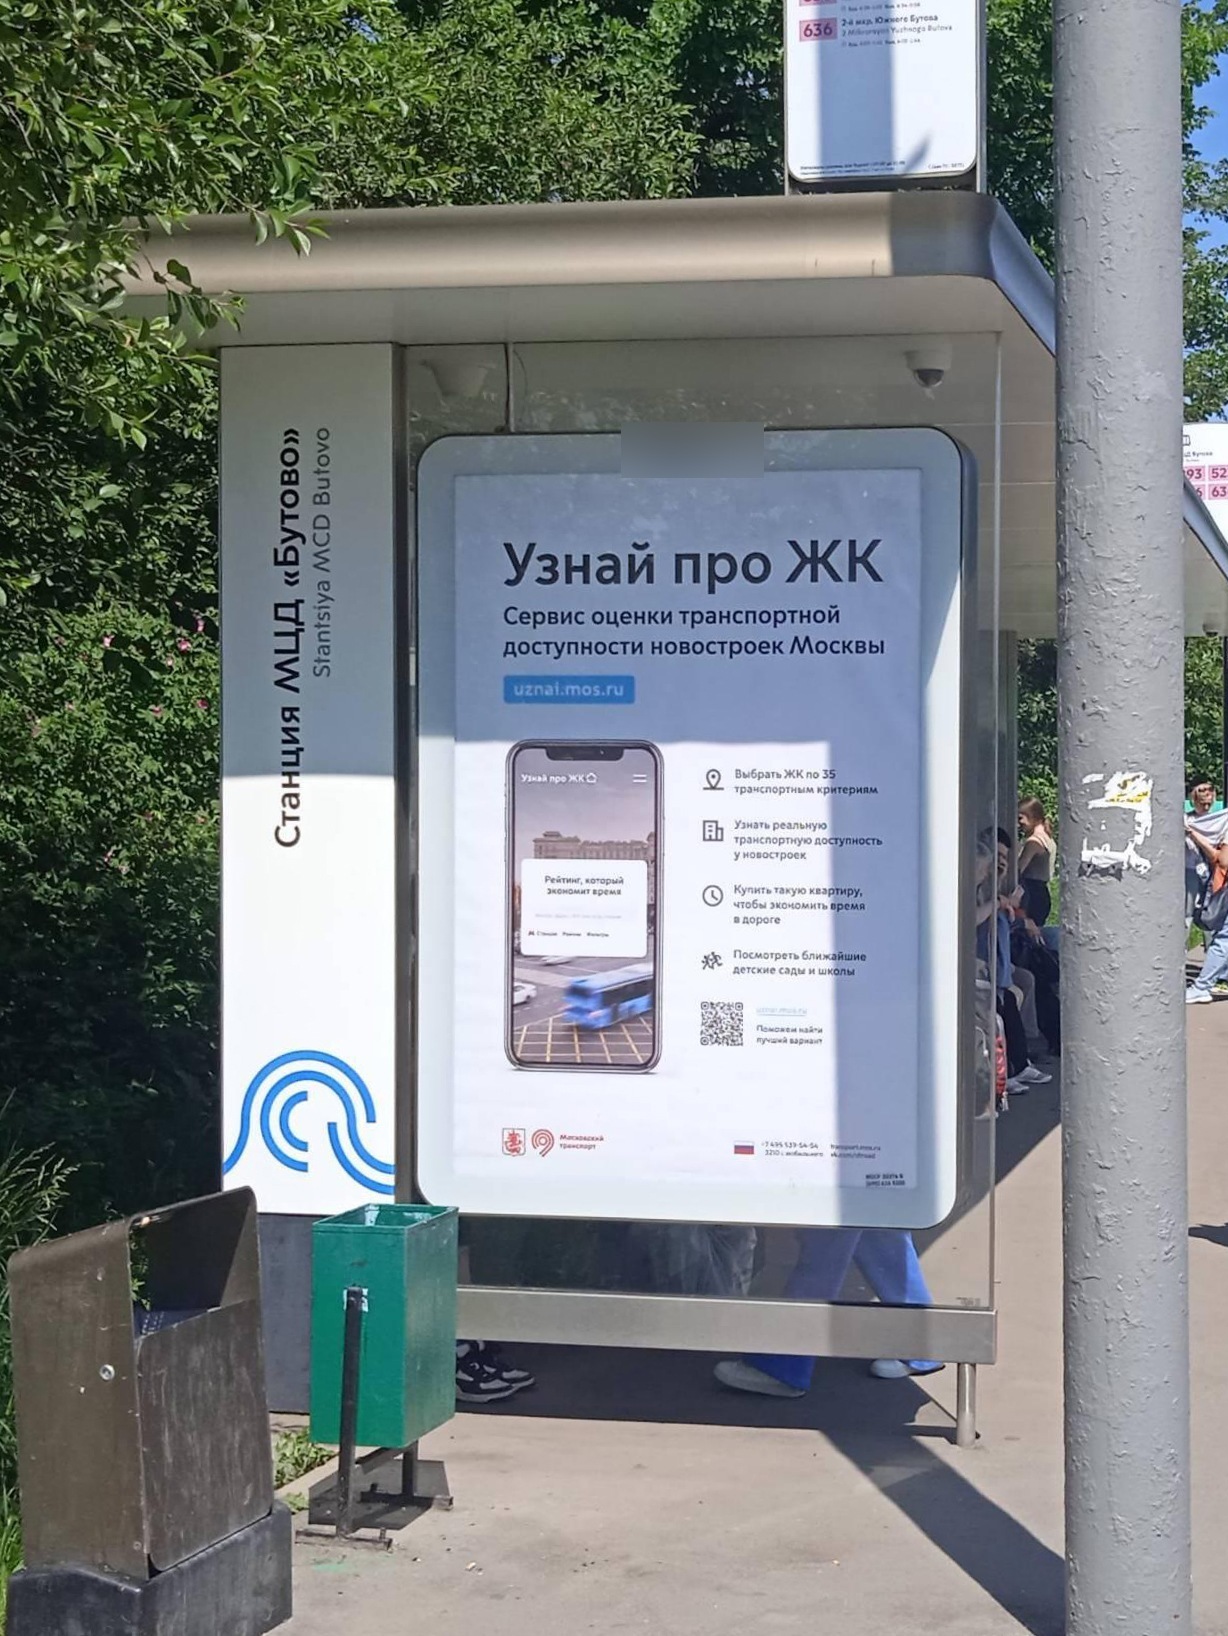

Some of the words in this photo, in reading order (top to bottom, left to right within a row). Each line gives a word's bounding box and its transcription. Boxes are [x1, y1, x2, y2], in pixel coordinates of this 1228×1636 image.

[875, 16, 908, 24] Южного
[803, 22, 833, 37] 636
[313, 427, 330, 505] Butovo
[274, 428, 306, 588] «Бутово»
[313, 514, 330, 572] MCD
[503, 541, 656, 586] Узнай
[674, 552, 772, 594] про
[785, 539, 884, 584] ЖК
[503, 606, 585, 629] Сервис
[591, 607, 673, 629] оценки
[679, 604, 840, 629] транспортной
[313, 580, 335, 678] Stantsiya
[274, 599, 305, 694] МЦД
[503, 638, 644, 660] доступности
[650, 637, 784, 659] новостроек
[790, 635, 886, 656] Москвы
[513, 681, 624, 698] uznai.mos.ru
[274, 706, 304, 848] Станция
[521, 774, 548, 782] Узнай
[549, 776, 567, 784] про
[568, 774, 585, 782] ЖК
[734, 768, 782, 780] Выбрать
[784, 769, 804, 779] ЖК
[806, 772, 820, 780] по
[822, 769, 836, 780] 35
[734, 786, 814, 796] транспортным
[817, 786, 878, 796] критериям
[734, 820, 770, 830] Узнать
[772, 821, 828, 832] реальную
[734, 836, 812, 846] транспортную
[814, 836, 883, 847] доступность
[734, 851, 740, 860] у
[742, 851, 807, 862] новостроек
[544, 876, 583, 886] Рейтинг,
[585, 876, 624, 886] который
[592, 888, 622, 896] время
[734, 885, 772, 896] Купить
[774, 888, 806, 898] такую
[809, 888, 864, 898] квартиру,
[734, 900, 767, 910] чтобы
[770, 902, 828, 911] экономить
[830, 902, 866, 912] время
[742, 916, 781, 926] дороге
[733, 950, 800, 962] Посмотреть
[802, 950, 867, 962] ближайшие
[733, 966, 776, 975] детские
[778, 967, 806, 976] сады
[808, 967, 816, 976] и
[818, 966, 856, 976] школы
[756, 1024, 797, 1033] Поможем
[799, 1026, 822, 1034] найти
[790, 1038, 822, 1046] вариант
